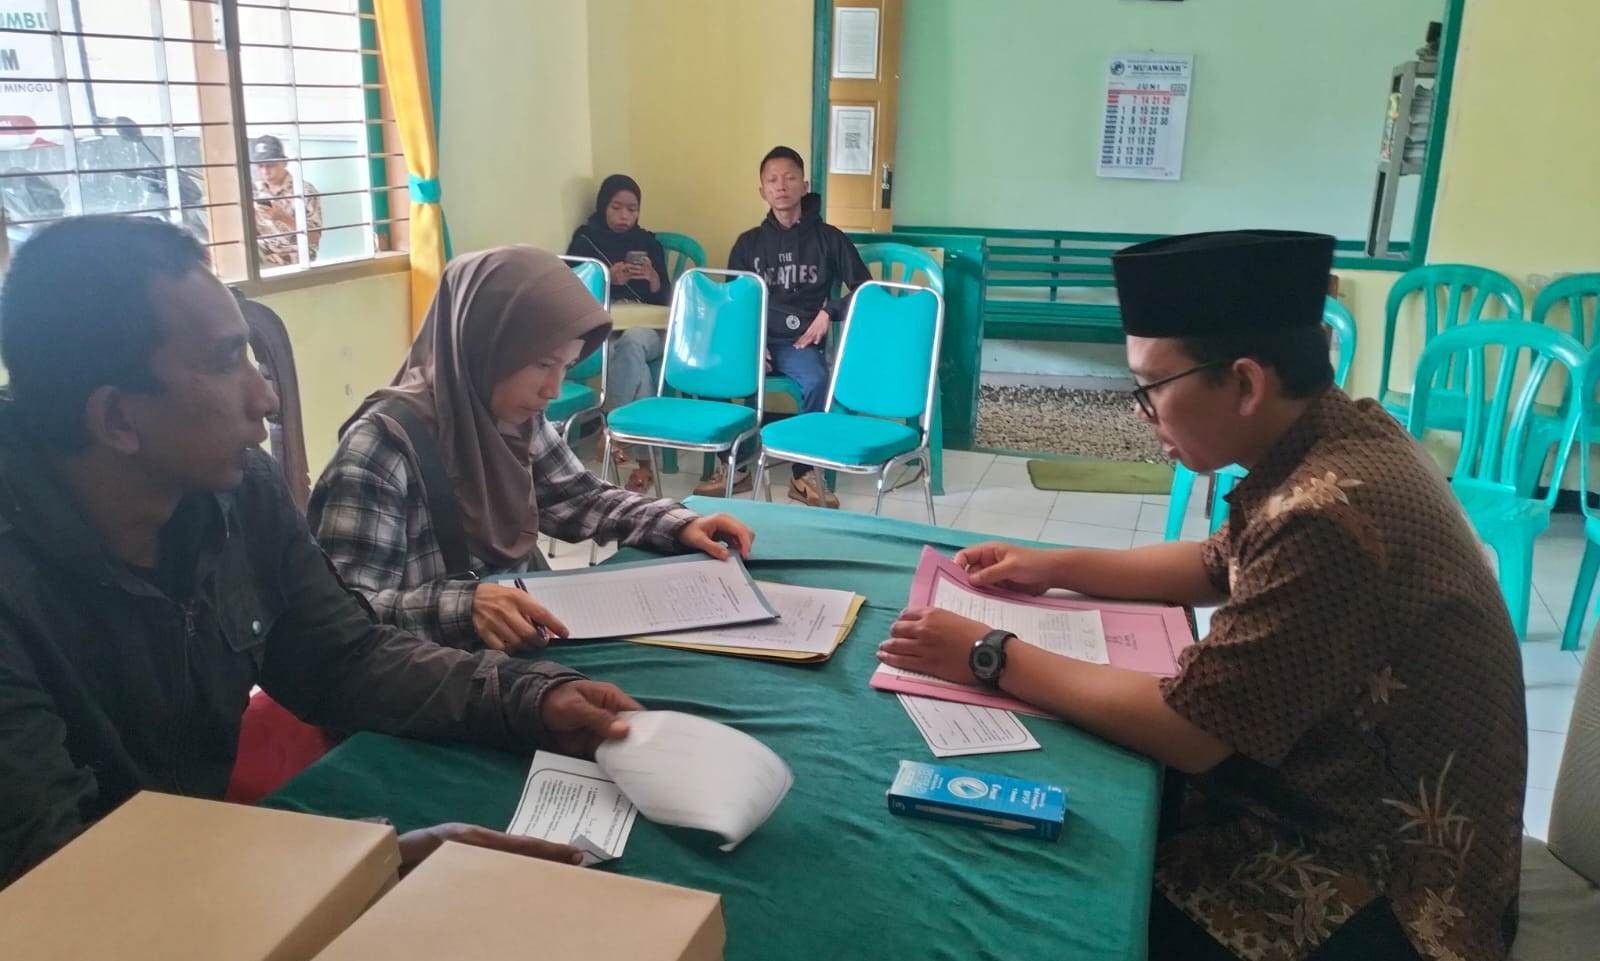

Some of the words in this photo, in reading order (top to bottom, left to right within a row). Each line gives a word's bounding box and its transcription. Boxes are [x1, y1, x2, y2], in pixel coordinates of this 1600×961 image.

[4, 83, 53, 93] MINGGU
[1142, 96, 1149, 104] 14
[1152, 96, 1160, 104] 21
[1140, 106, 1148, 114] 15
[1150, 106, 1159, 115] 22
[1161, 106, 1169, 115] 29
[1149, 116, 1158, 125] 23
[1160, 117, 1168, 125] 30
[1128, 126, 1136, 135] 10
[1139, 126, 1146, 135] 17
[1148, 127, 1157, 135] 24
[1138, 136, 1145, 144] 18
[1147, 137, 1155, 145] 25
[1126, 146, 1133, 155] 12
[1147, 147, 1154, 155] 26
[1146, 157, 1154, 165] 27
[778, 252, 792, 262] THE
